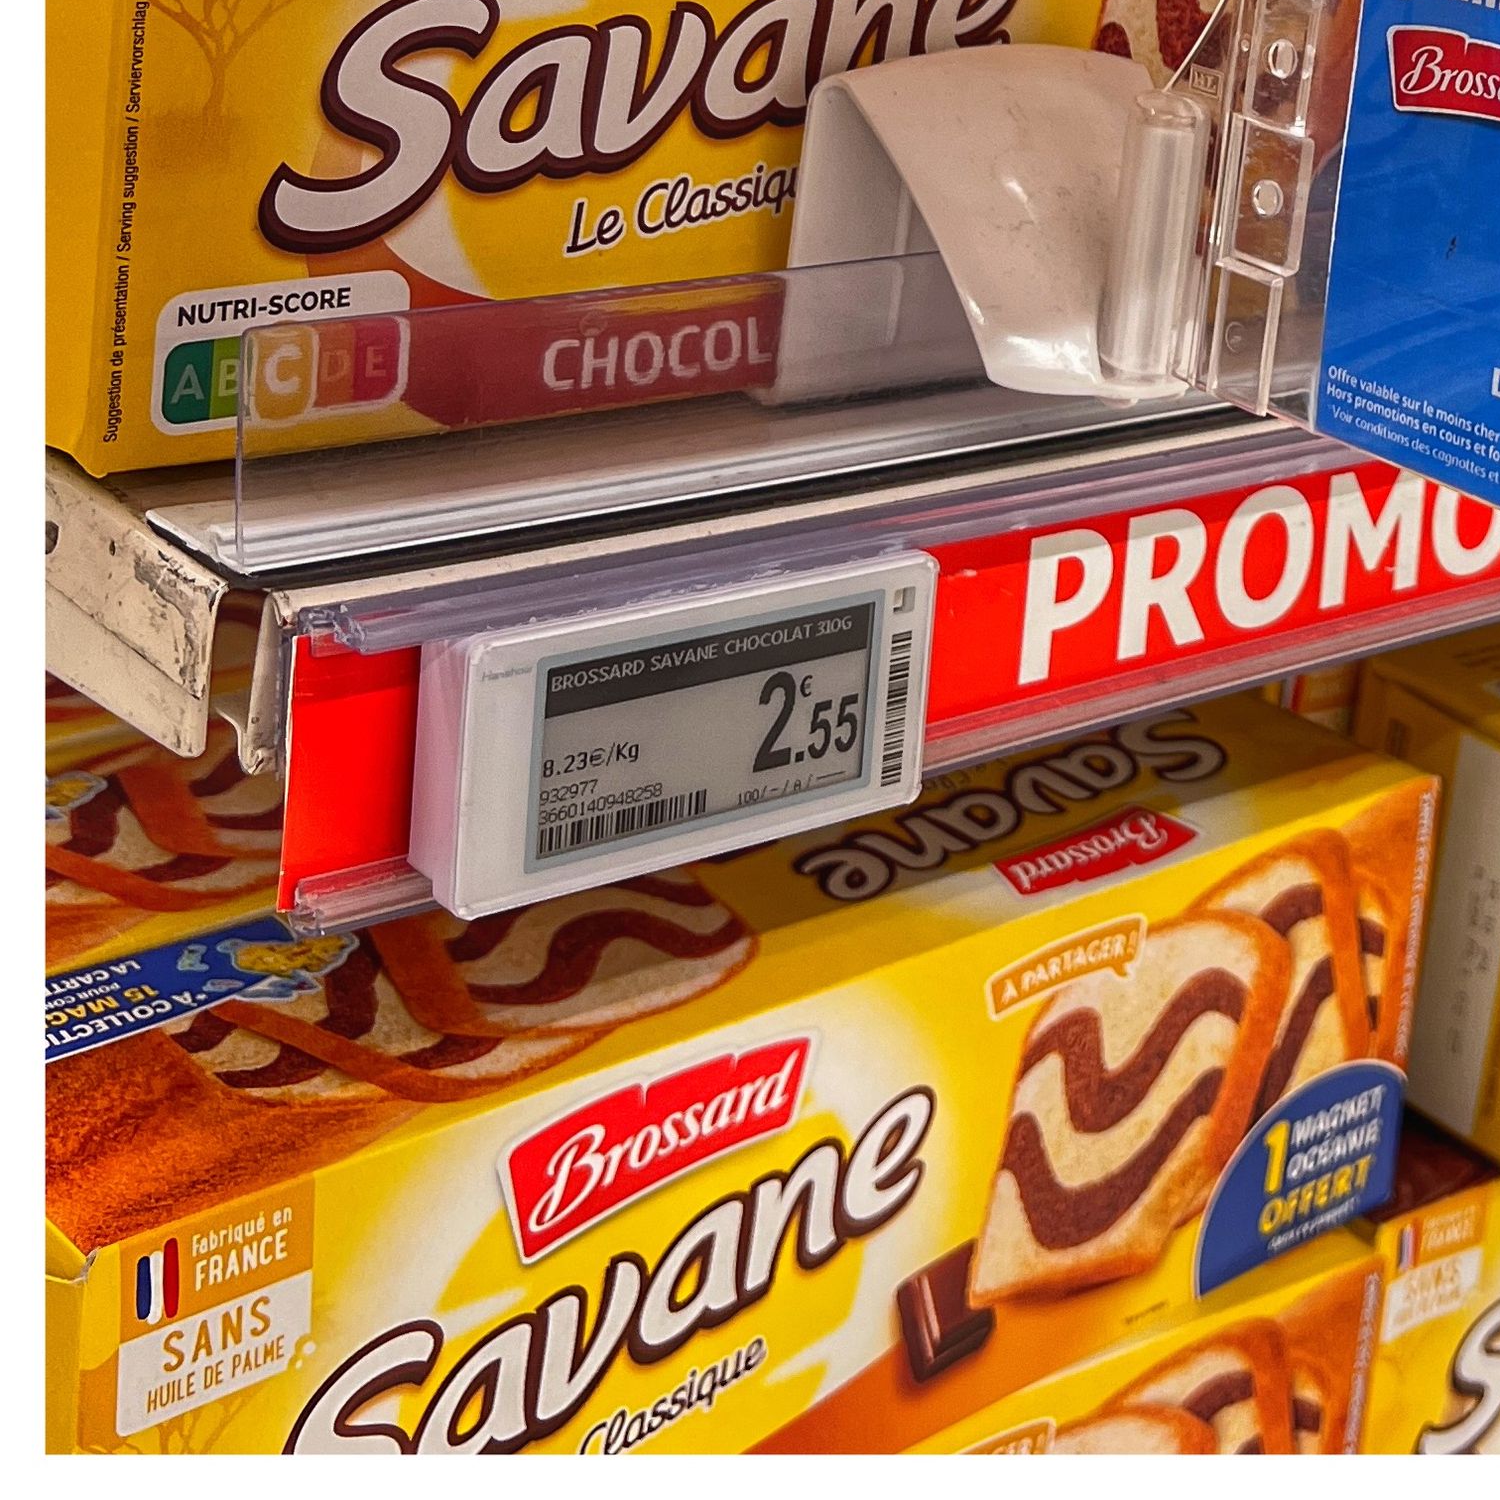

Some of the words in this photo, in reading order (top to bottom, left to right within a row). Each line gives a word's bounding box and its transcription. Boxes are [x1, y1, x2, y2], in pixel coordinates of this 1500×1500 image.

[126, 1, 149, 113] Serviervorschlag
[123, 126, 139, 198] suggestion
[117, 202, 137, 253] Serving
[571, 202, 625, 252] Le
[637, 164, 799, 235] Classiq
[111, 264, 129, 347] présentation
[176, 286, 352, 328] NUTRI-SCORE
[109, 350, 124, 366] de
[541, 317, 774, 393] CHOCOL
[103, 369, 122, 443] Suggestion
[1326, 382, 1353, 406] Hors
[1354, 393, 1421, 433] promotions
[1422, 420, 1437, 437] en
[1439, 427, 1473, 451] cours
[1473, 439, 1487, 456] et
[1327, 365, 1358, 389] Offre
[1359, 377, 1400, 405] valable
[1401, 395, 1421, 412] sur
[1422, 399, 1435, 417] le
[1435, 408, 1473, 436] moins
[1474, 420, 1500, 443] cher
[1355, 415, 1410, 450] conditions
[1411, 435, 1431, 456] des
[1432, 444, 1488, 480] cagnottes
[1488, 468, 1500, 484] et
[550, 658, 646, 694] BROSSARD
[649, 643, 719, 672] SAVANE
[724, 622, 813, 656] CHOCOLAT
[815, 615, 853, 637] 310G
[538, 779, 599, 805] 932977
[538, 782, 663, 826] 3660140948258
[794, 708, 1227, 902] Savane
[1010, 810, 1170, 892] Brossard
[45, 998, 173, 1048] COLLECTI
[528, 1049, 799, 1235] Brossard
[1264, 1119, 1291, 1195] 1
[1290, 1083, 1387, 1148] MAGNET
[191, 1216, 266, 1258] Fabriqué
[272, 1206, 293, 1226] en
[1258, 1154, 1376, 1235] OFFERT
[194, 1229, 289, 1291] FRANCE
[284, 1084, 937, 1454] Savane
[162, 1296, 272, 1373] SANS
[147, 1374, 197, 1414] HUILE
[203, 1362, 228, 1392] DE
[231, 1335, 286, 1379] PALME
